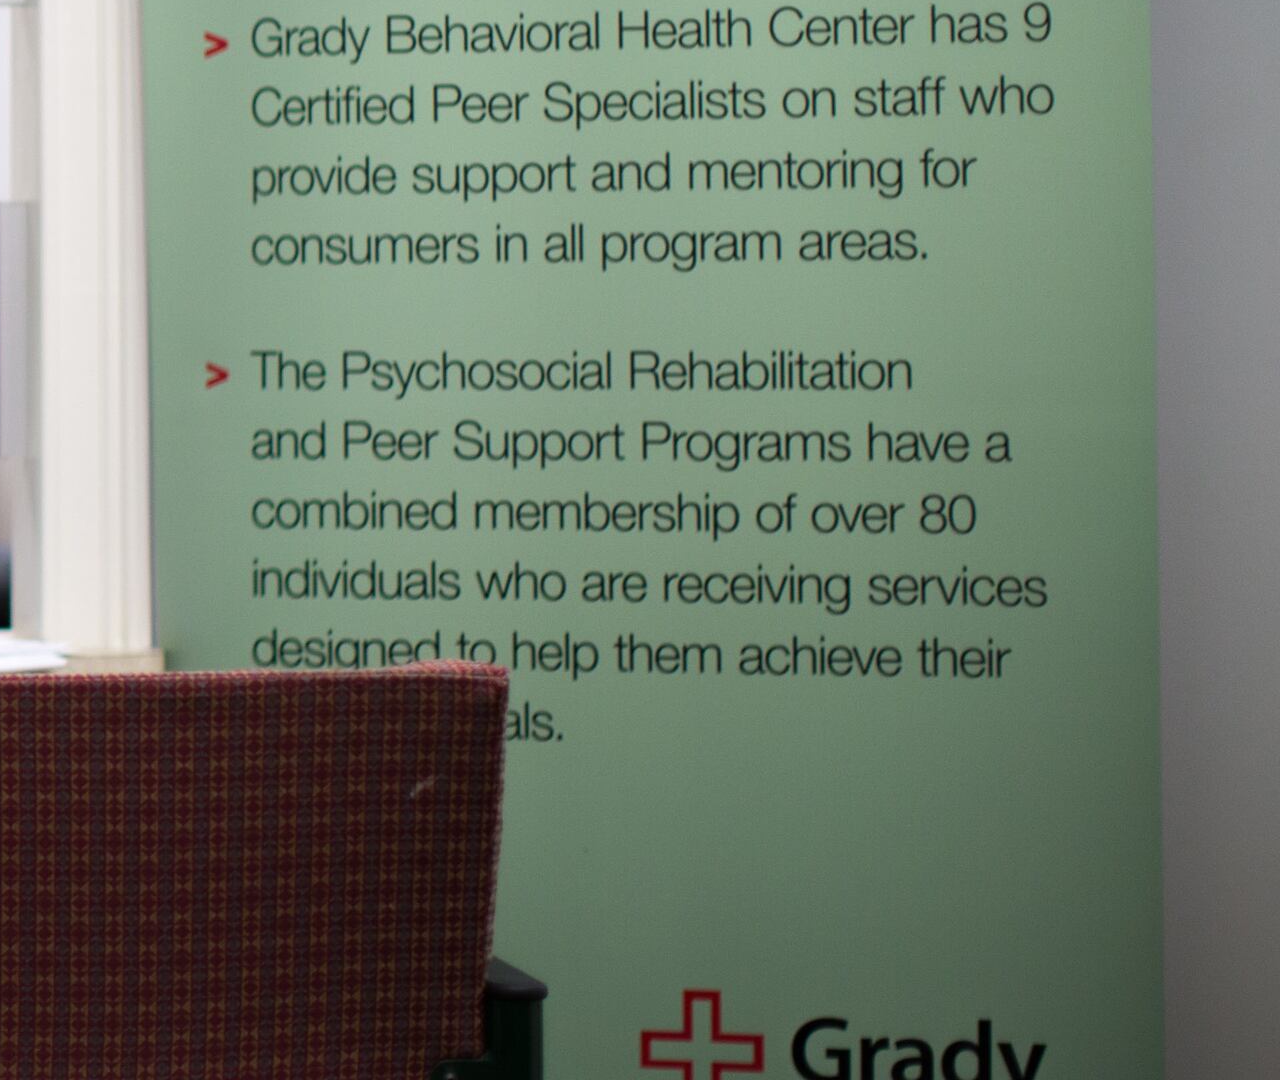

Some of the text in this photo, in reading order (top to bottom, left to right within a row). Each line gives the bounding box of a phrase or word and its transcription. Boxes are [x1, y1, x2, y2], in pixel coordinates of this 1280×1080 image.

[250, 1, 1052, 66] Grady Behavioral Health Center has 9
[251, 74, 1055, 132] Certified Peer Specialists on staff who
[252, 147, 978, 206] provide support and mentoring for
[250, 222, 928, 273] consumers in all program areas.
[250, 349, 913, 401] The Psychosocial Rehabilitation
[250, 418, 1013, 473] and Peer Support Programs have a
[251, 489, 977, 543] combined membership of over 80
[252, 558, 1048, 616] individuals who are receiving services
[251, 627, 1012, 681] designed to help them achieve their
[791, 1016, 1047, 1080] Grady
